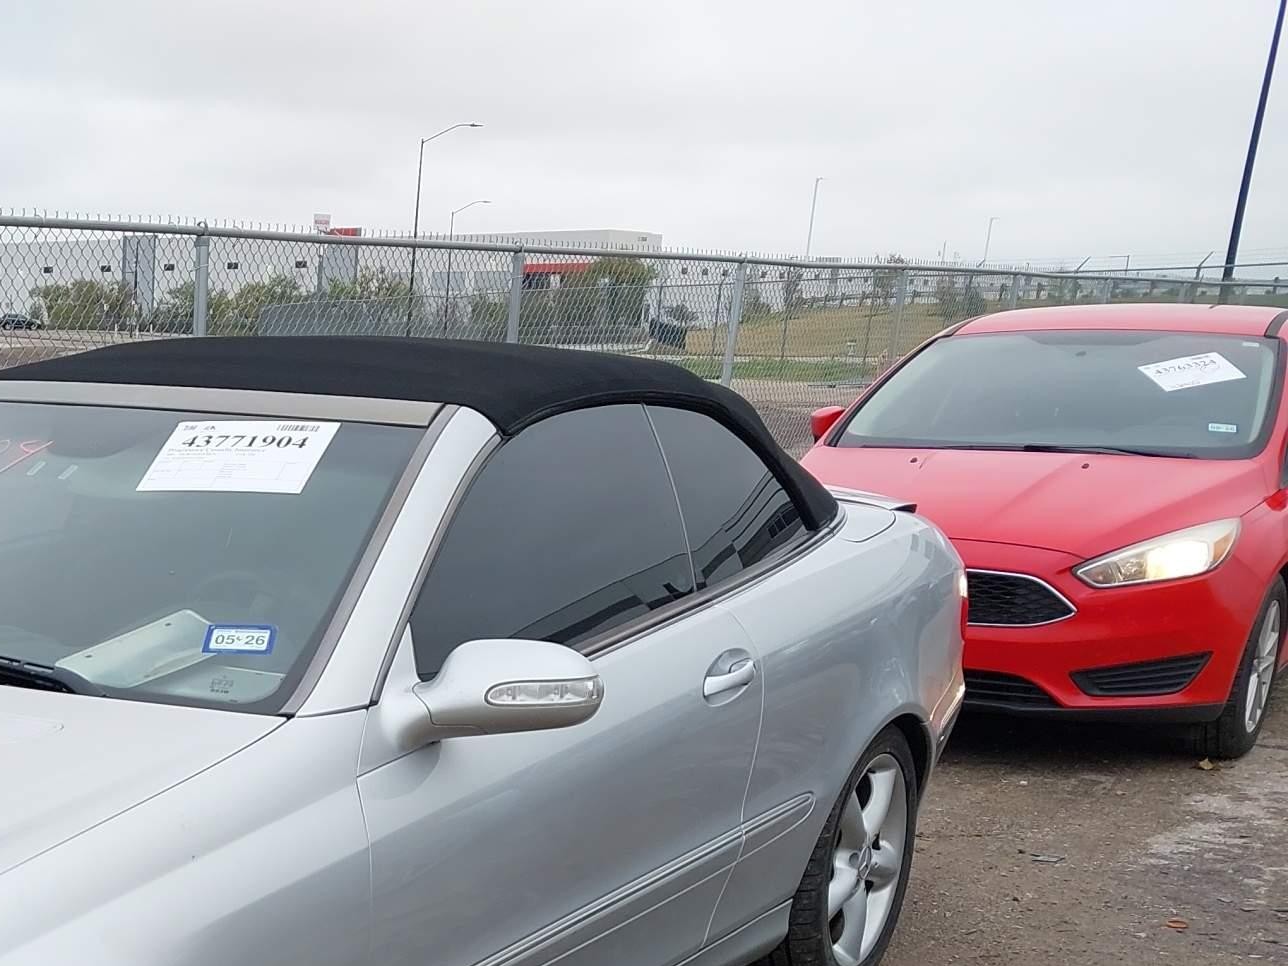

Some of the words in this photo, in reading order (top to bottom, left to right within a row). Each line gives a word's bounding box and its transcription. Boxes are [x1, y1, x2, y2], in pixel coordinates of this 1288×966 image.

[181, 435, 310, 449] 43771904
[214, 634, 236, 645] 05
[244, 635, 266, 646] 26
